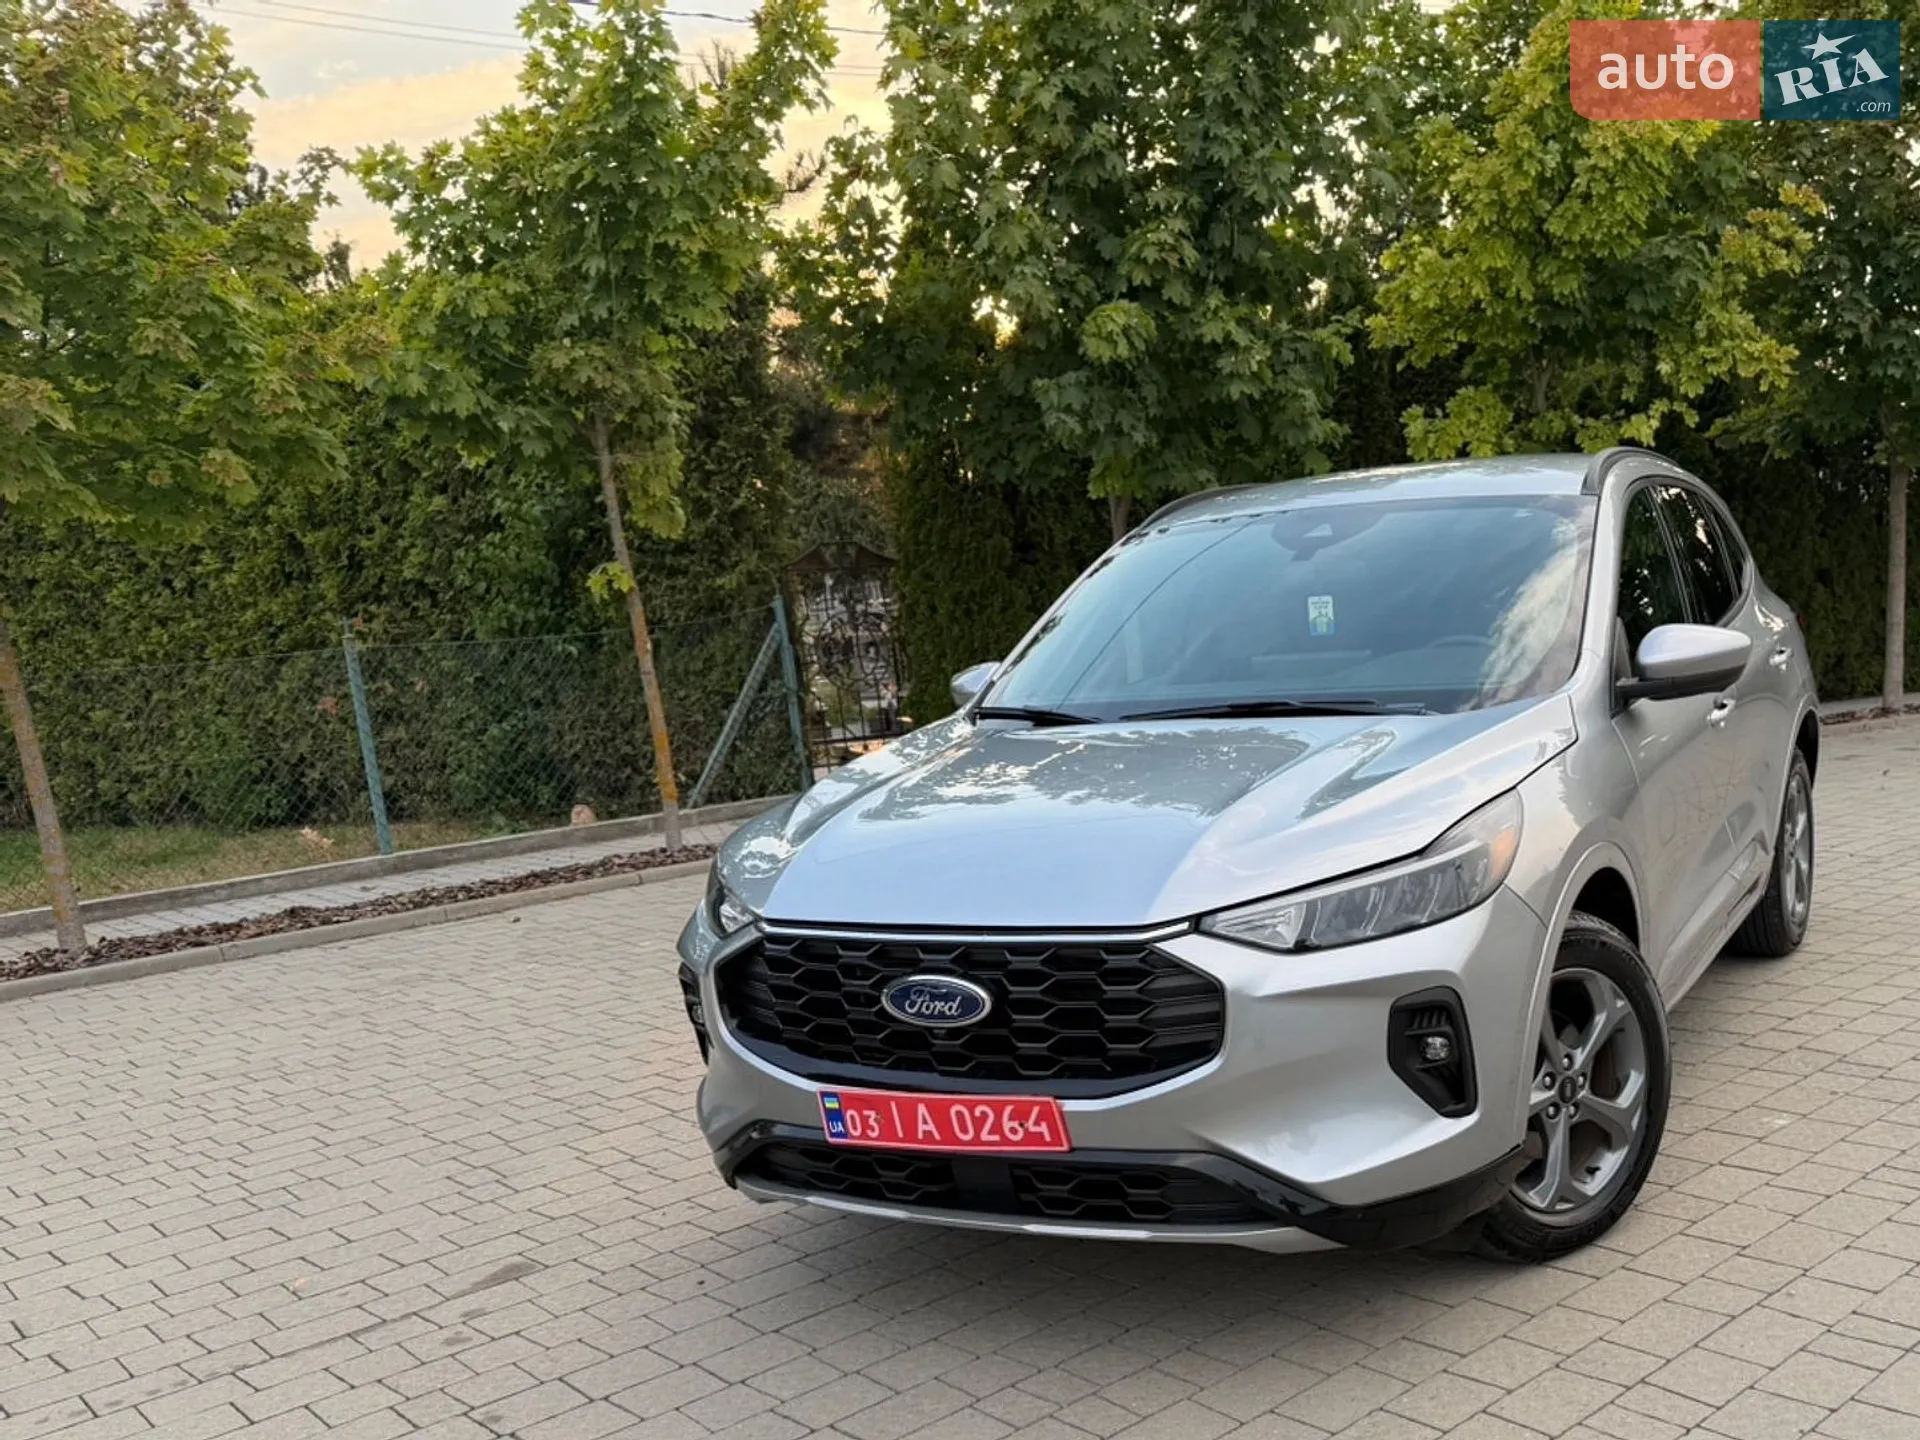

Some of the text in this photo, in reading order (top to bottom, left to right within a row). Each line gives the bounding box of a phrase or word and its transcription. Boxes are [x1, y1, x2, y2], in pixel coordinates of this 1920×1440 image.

[905, 986, 962, 1016] Ford
[829, 1121, 846, 1134] UA
[951, 1104, 1052, 1142] 0264
